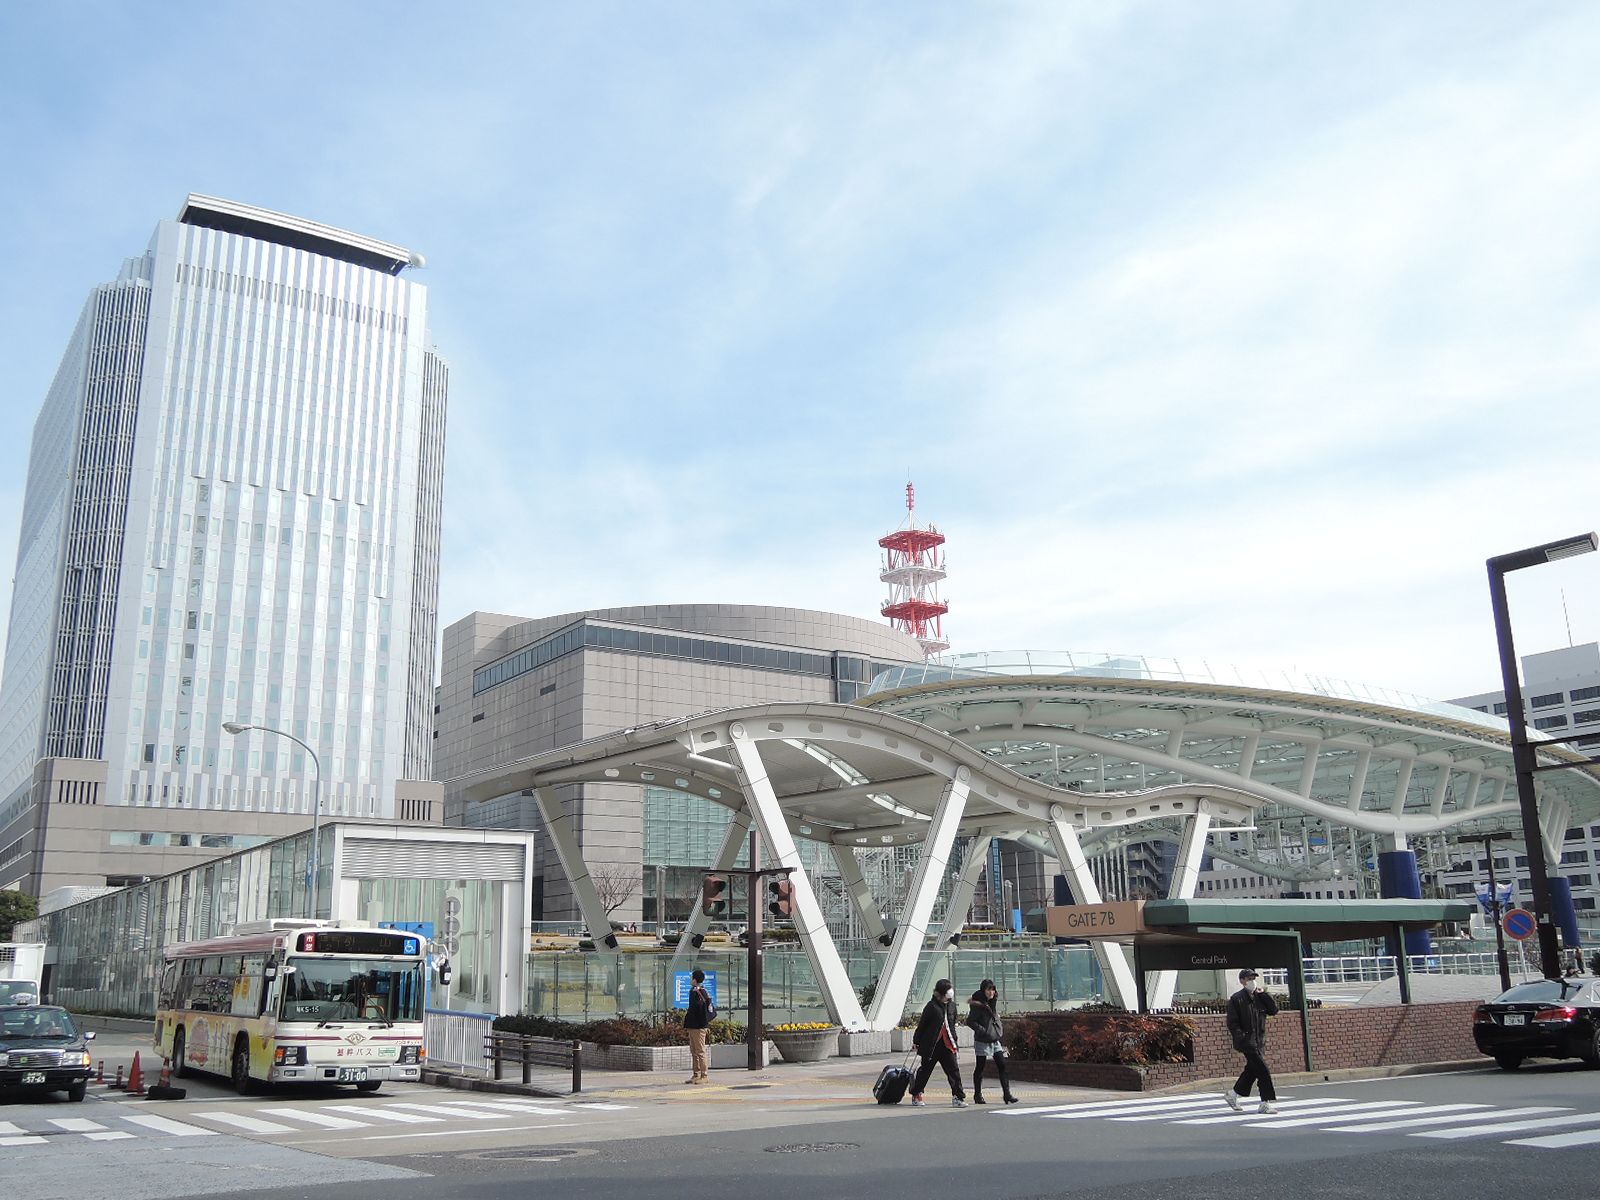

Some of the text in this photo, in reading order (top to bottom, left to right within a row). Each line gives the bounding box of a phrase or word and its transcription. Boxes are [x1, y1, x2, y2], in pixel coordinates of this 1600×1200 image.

[1068, 911, 1115, 927] GATE 7B
[1191, 955, 1228, 965] Central Park
[296, 1005, 319, 1013] NKS-15
[336, 1048, 373, 1057] 基幹バス
